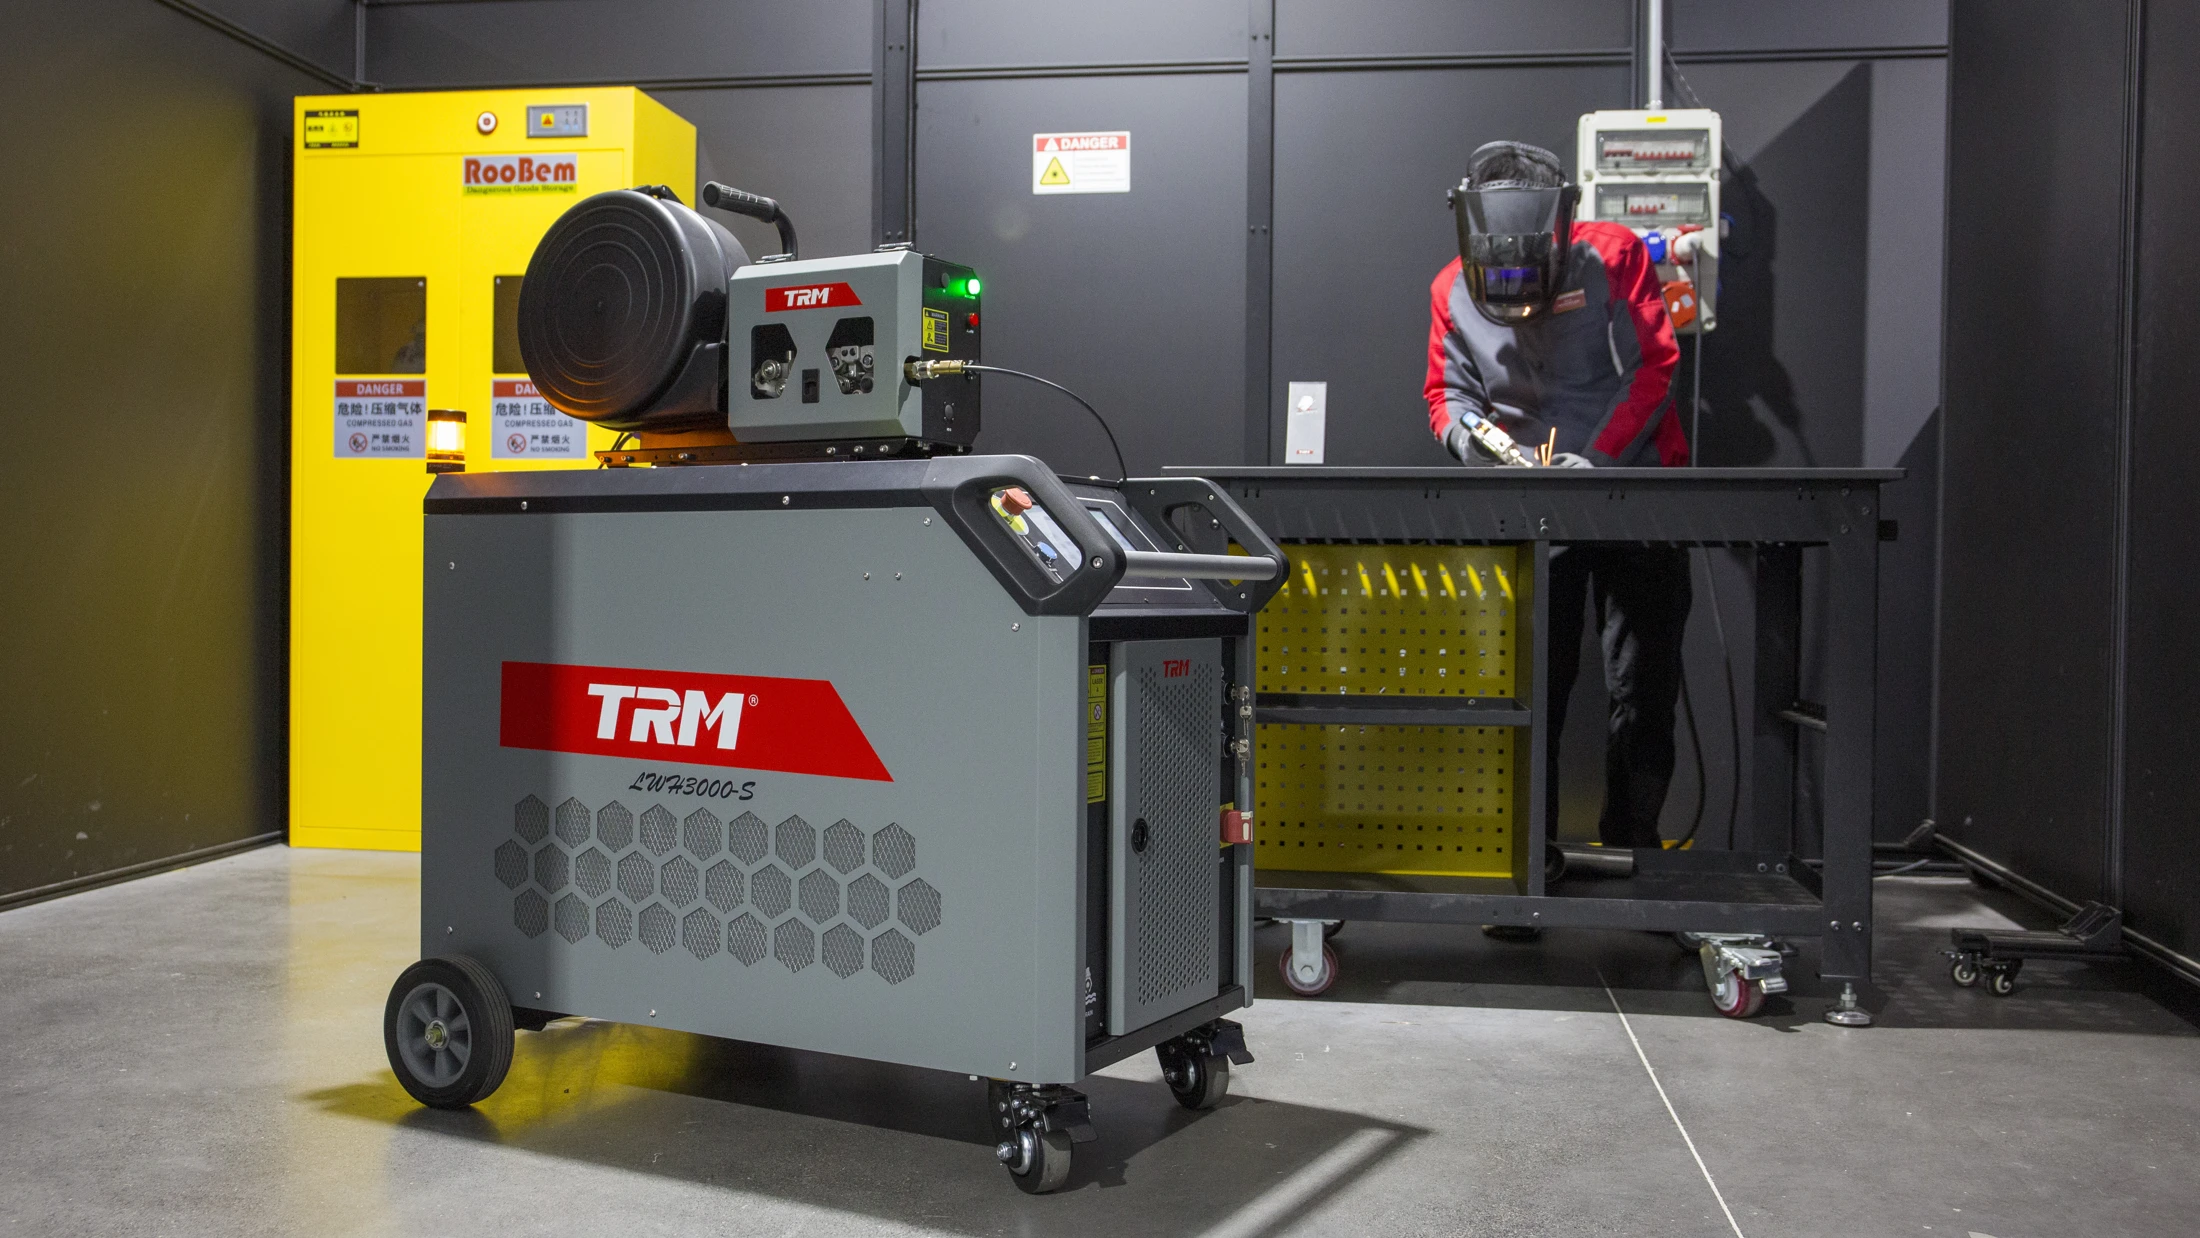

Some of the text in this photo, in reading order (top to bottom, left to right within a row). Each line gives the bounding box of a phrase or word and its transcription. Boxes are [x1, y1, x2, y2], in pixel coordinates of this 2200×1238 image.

[1060, 137, 1118, 150] DANGER
[464, 157, 575, 184] RooBem
[466, 183, 574, 195] Dangerous Goods Storage
[356, 383, 404, 395] DANGER
[515, 383, 540, 395] DAN
[338, 401, 422, 416] 危险!压缩气体
[346, 418, 413, 428] COMPRESSED GAS
[505, 419, 573, 428] COMPRESSED GAS
[371, 434, 410, 444] 严禁烟火
[530, 434, 570, 444] 严禁烟火
[1163, 659, 1190, 678] TRM
[628, 771, 756, 801] LWH3000-S
